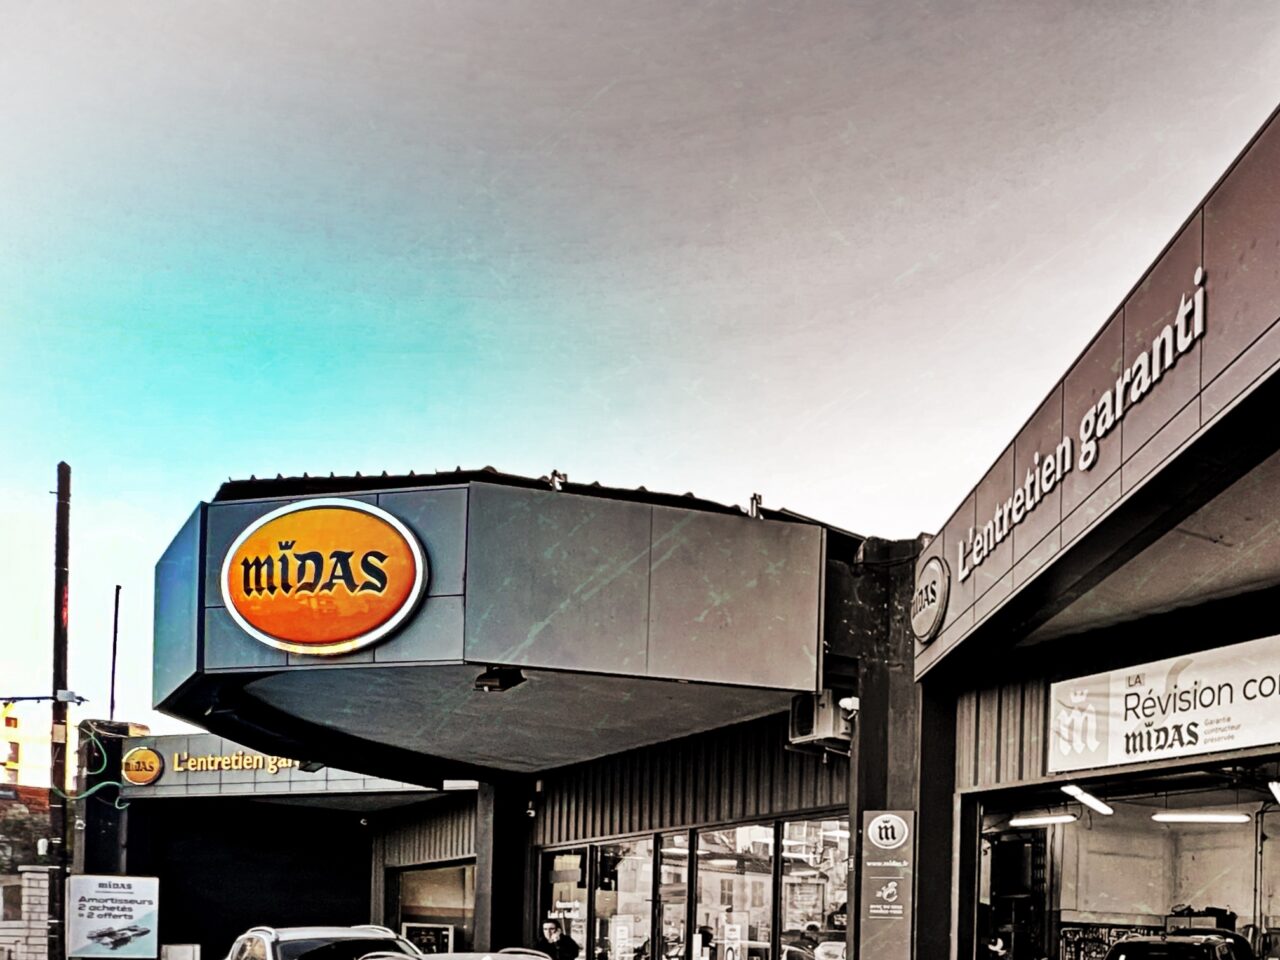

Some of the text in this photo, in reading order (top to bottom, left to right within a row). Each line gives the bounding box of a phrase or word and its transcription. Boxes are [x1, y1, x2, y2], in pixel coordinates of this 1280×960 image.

[957, 266, 1205, 582] L'entretien garanti
[1128, 674, 1145, 688] LA
[1124, 681, 1234, 722] Révision
[173, 751, 263, 772] L'entretien
[78, 895, 154, 905] Amortisseurs
[78, 903, 134, 912] 2 achetés
[86, 911, 95, 919] 2
[97, 912, 134, 920] offerts
